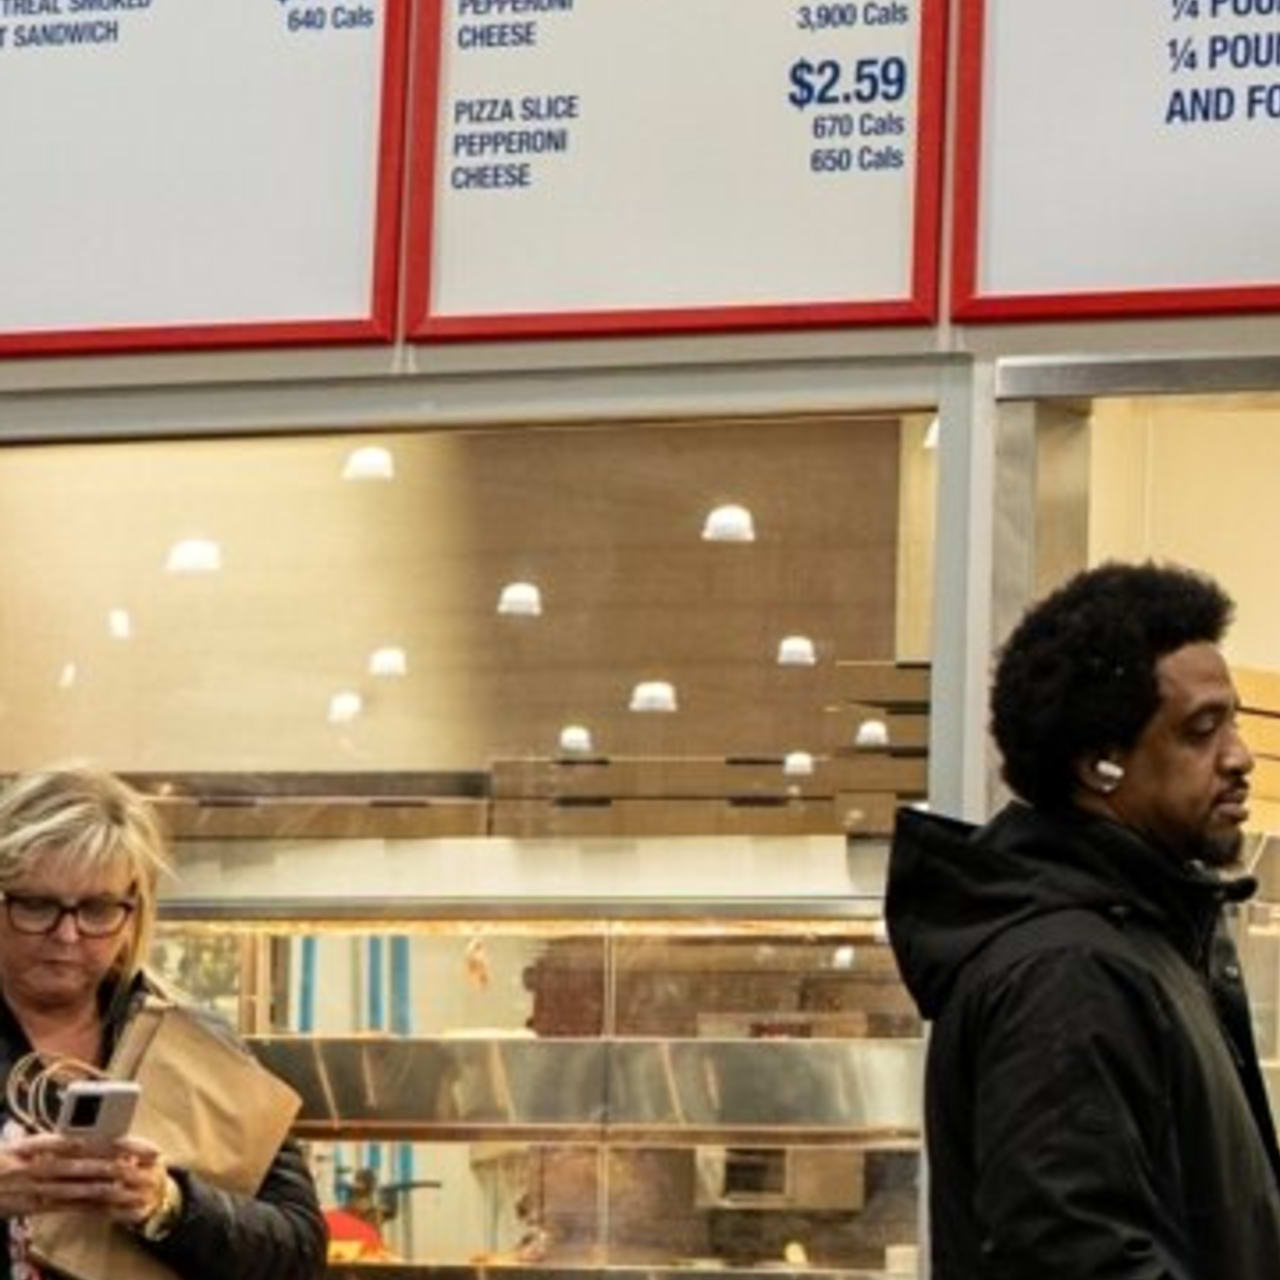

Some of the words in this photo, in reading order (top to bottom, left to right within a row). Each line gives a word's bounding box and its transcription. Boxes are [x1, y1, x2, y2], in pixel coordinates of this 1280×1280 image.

[287, 9, 326, 32] 640
[331, 5, 374, 30] Cals
[863, 1, 909, 26] Cals
[13, 20, 119, 48] SANDWICH
[457, 22, 535, 49] CHEESE
[788, 56, 907, 110] $2.59
[454, 99, 514, 124] PIZZA
[520, 95, 579, 120] SLICE
[1165, 88, 1235, 124] AND
[812, 115, 854, 139] 670
[859, 112, 905, 137] Cals
[453, 129, 568, 157] PEPPERONI
[810, 149, 852, 173] 650
[859, 146, 904, 171] Cals
[450, 163, 531, 190] CHEESE
